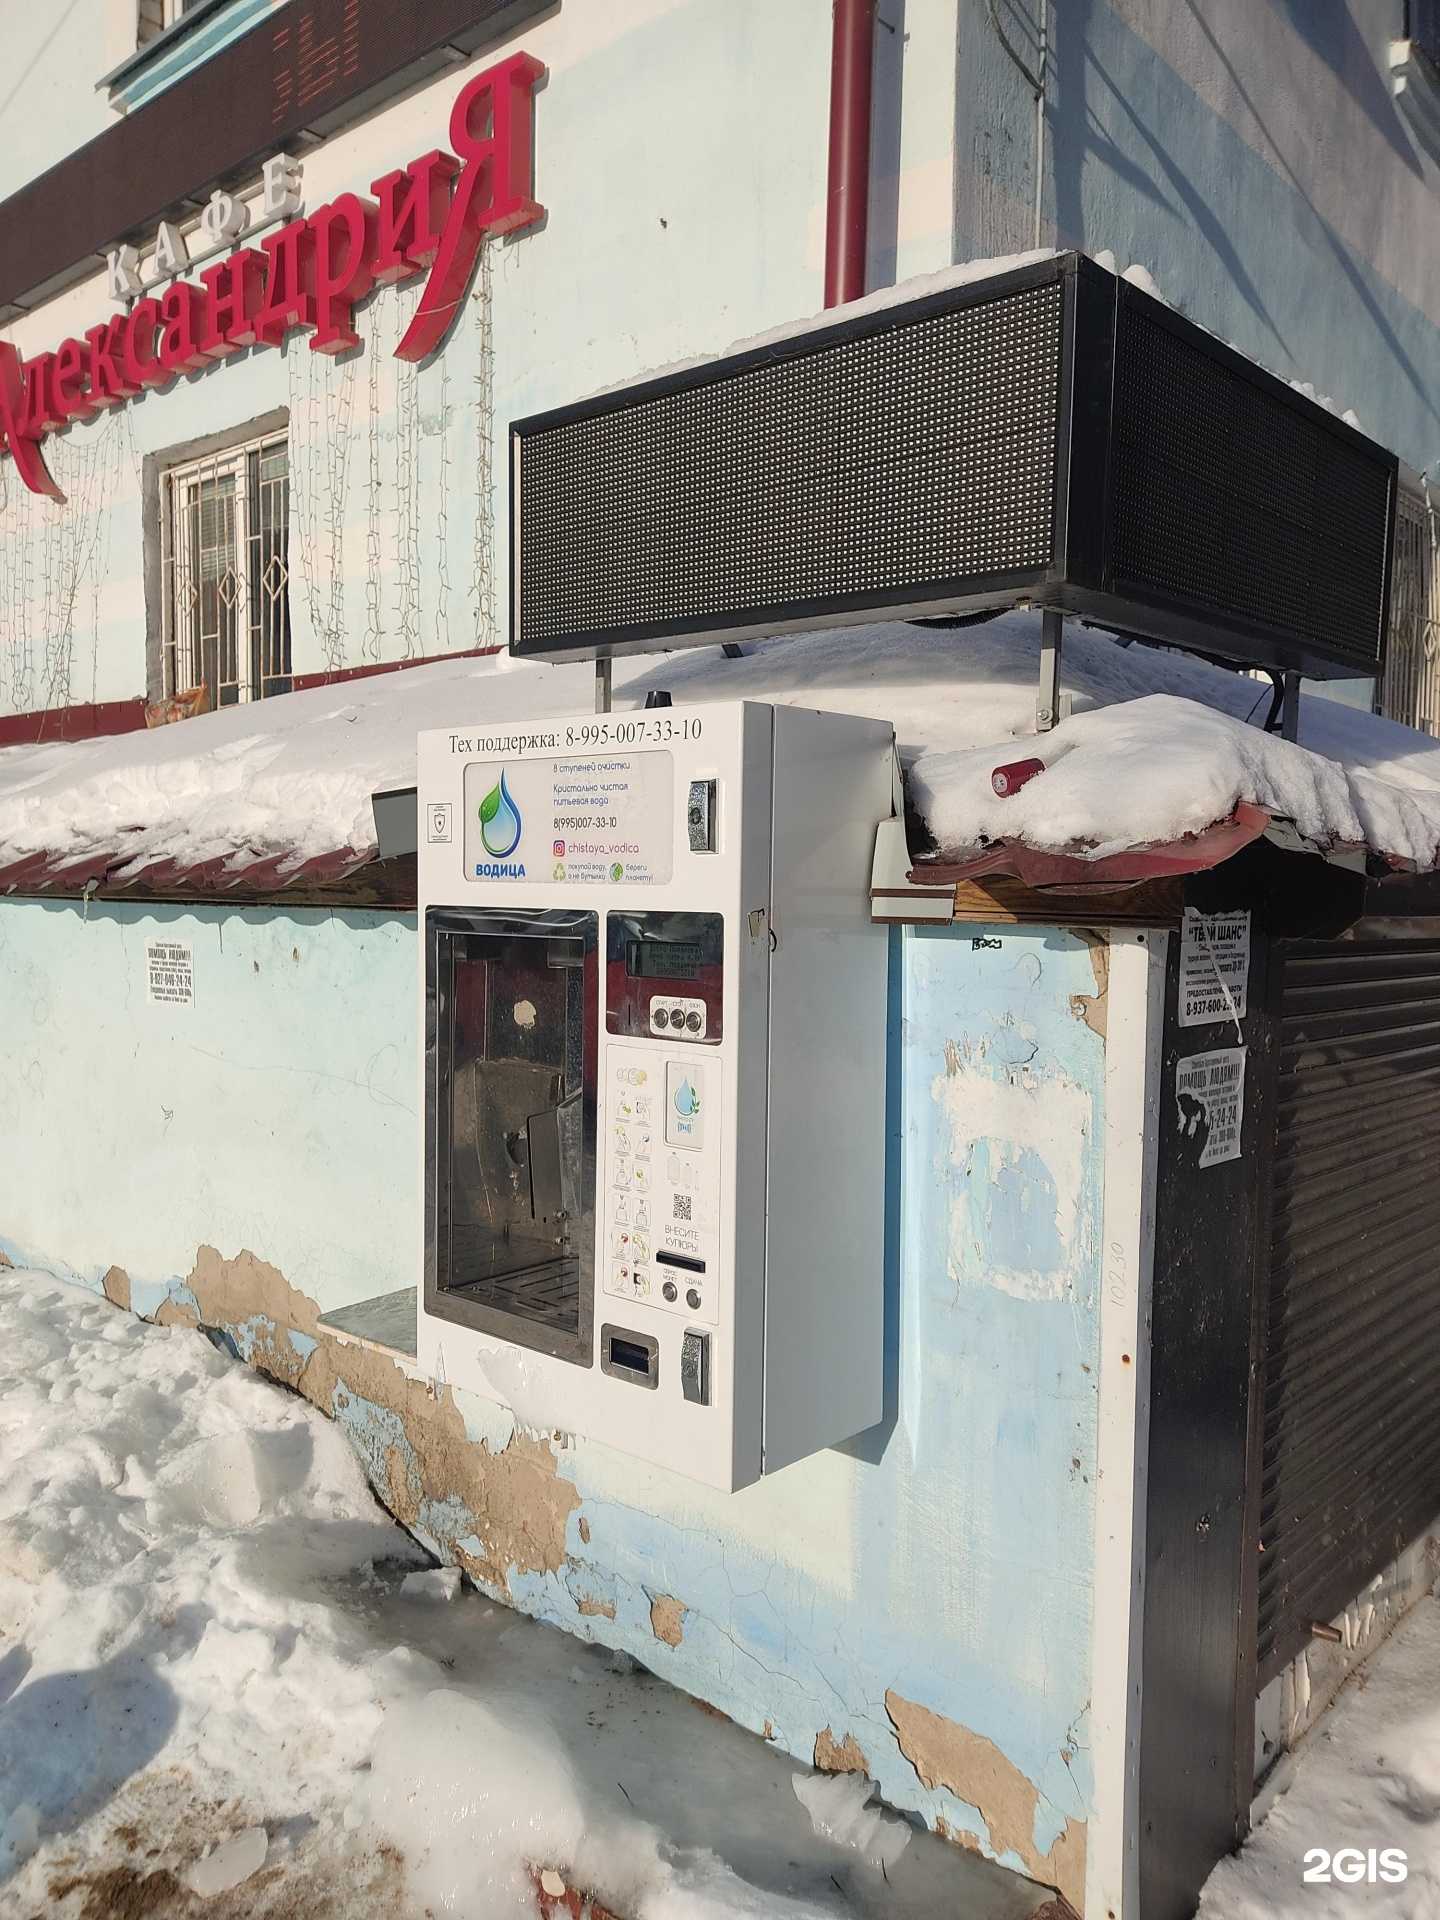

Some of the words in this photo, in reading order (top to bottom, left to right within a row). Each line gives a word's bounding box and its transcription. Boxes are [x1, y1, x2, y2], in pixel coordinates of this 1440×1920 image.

[107, 152, 304, 302] КАФЕ
[449, 735, 473, 753] Тех
[477, 732, 561, 755] поддержка:
[565, 717, 703, 747] 8-995-007-33-10
[559, 761, 596, 774] ступеней
[597, 761, 631, 771] очистки
[553, 783, 598, 795] Кристально
[599, 782, 629, 791] чистая
[553, 797, 589, 806] питьевая
[590, 796, 609, 807] вода
[553, 816, 617, 831] 8(995)007-33-10
[568, 841, 640, 856] chistaya_vodica
[475, 863, 526, 879] ВОДИЦА
[664, 1224, 701, 1242] ВНЕСИТЕ
